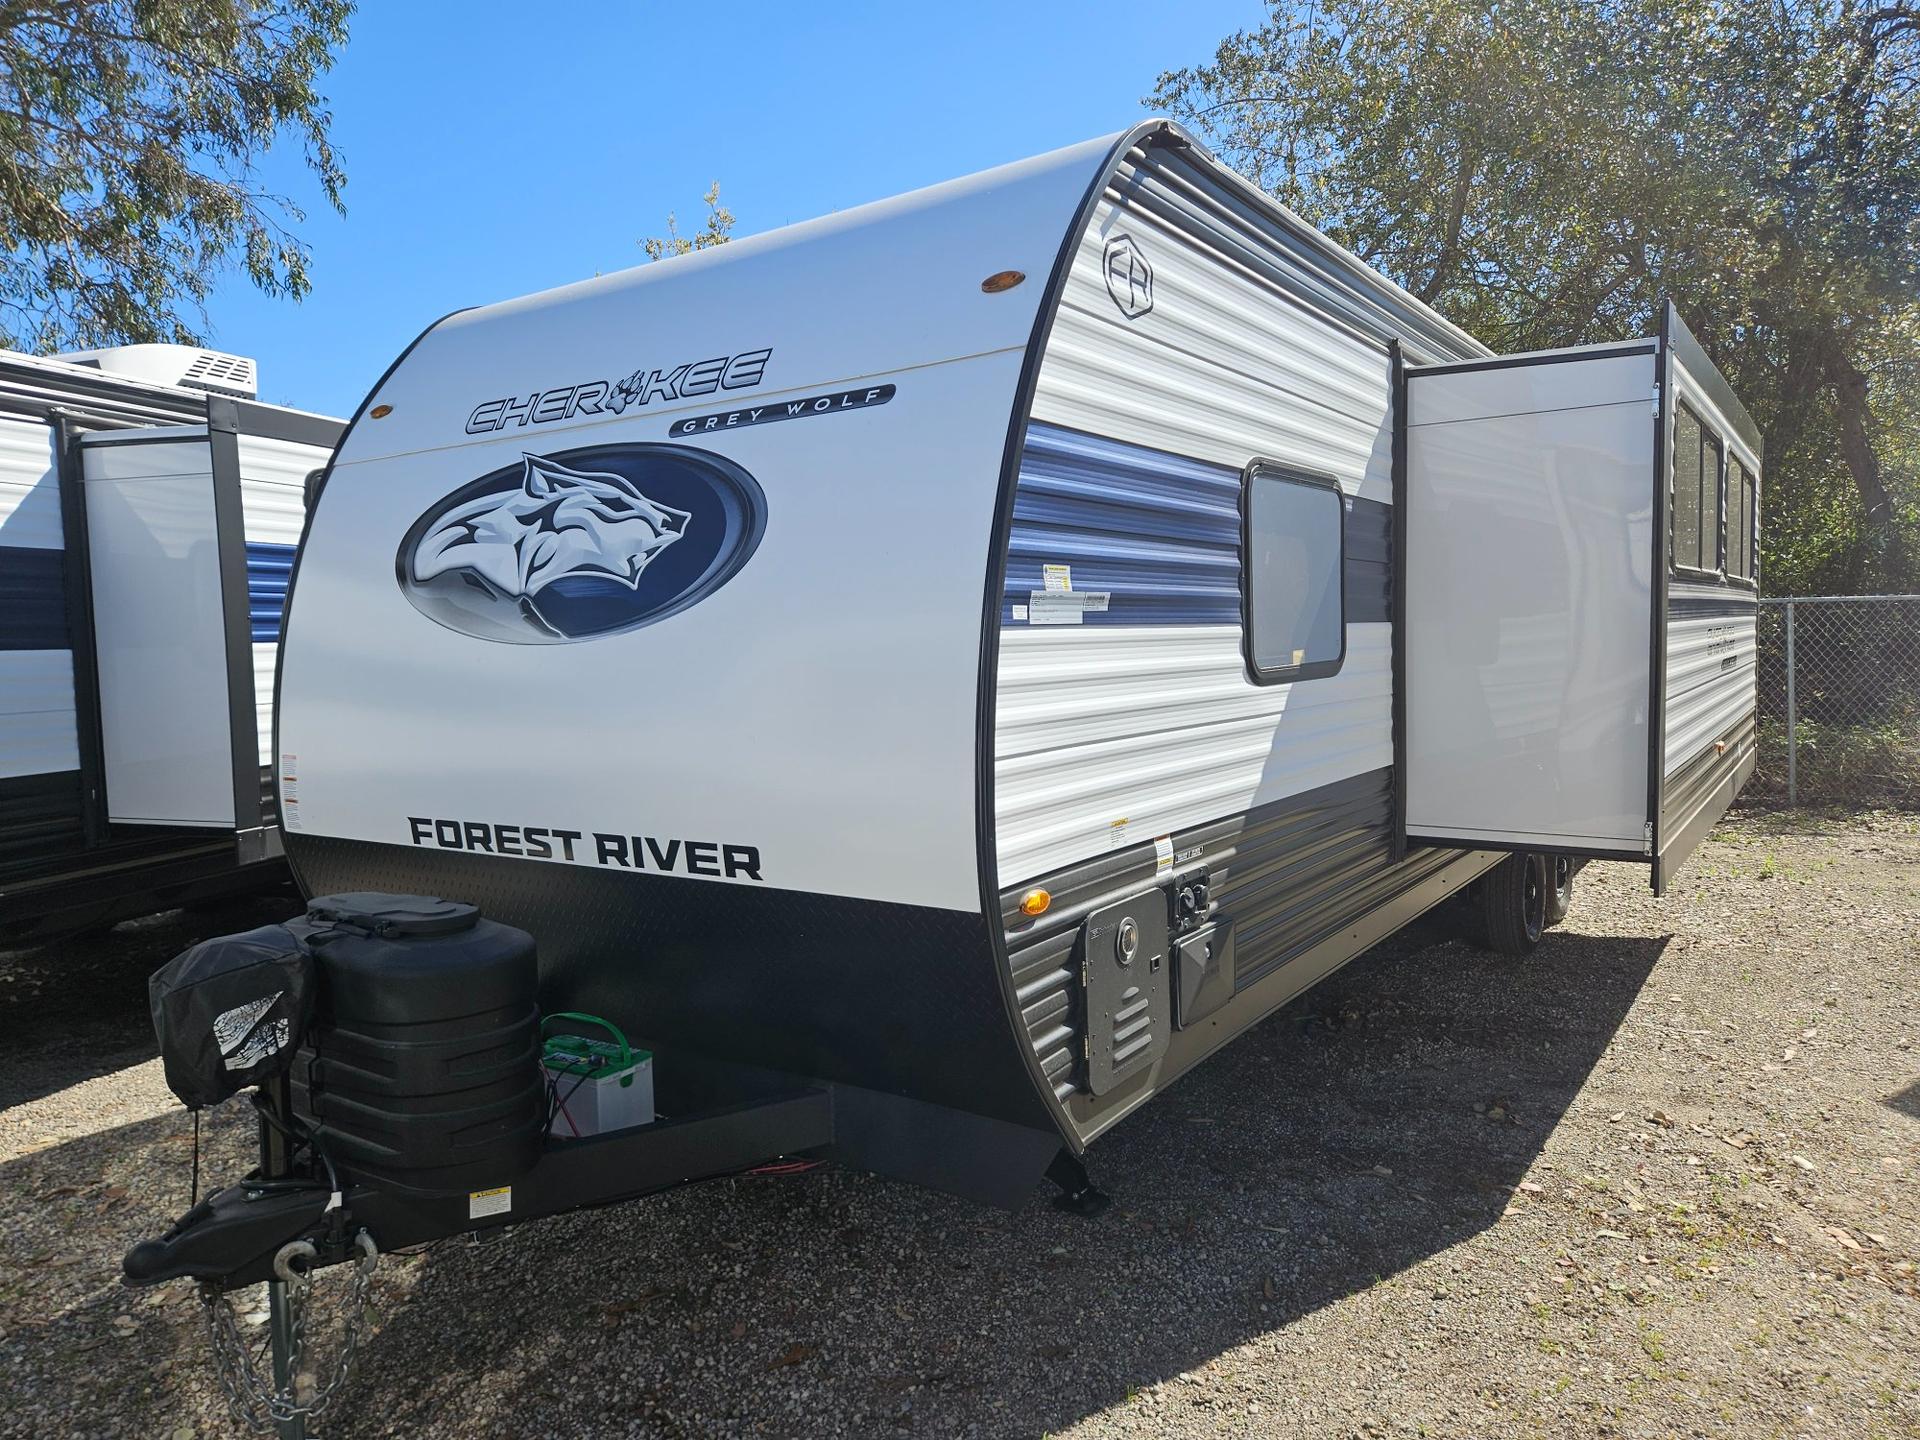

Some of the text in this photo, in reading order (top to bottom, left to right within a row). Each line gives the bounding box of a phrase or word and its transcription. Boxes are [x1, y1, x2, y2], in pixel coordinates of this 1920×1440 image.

[682, 389, 881, 433] GREY WOLF
[407, 816, 764, 881] FOREST RIVER
